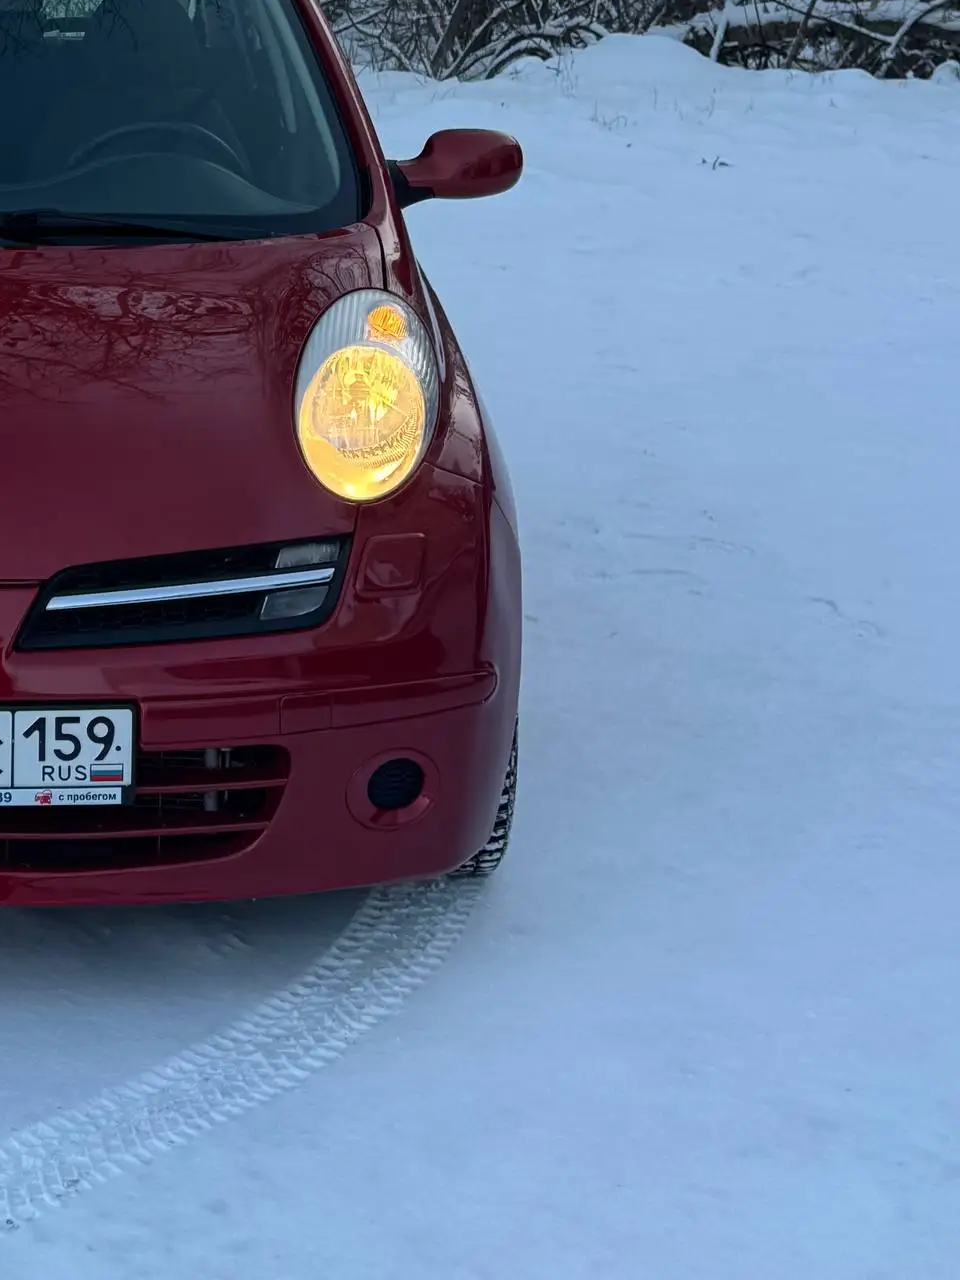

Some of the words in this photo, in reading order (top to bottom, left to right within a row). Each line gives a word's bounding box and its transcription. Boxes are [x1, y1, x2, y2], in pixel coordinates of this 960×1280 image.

[22, 715, 116, 762] 159
[41, 764, 87, 781] RUS
[58, 793, 65, 801] с
[66, 791, 117, 803] пробегом
